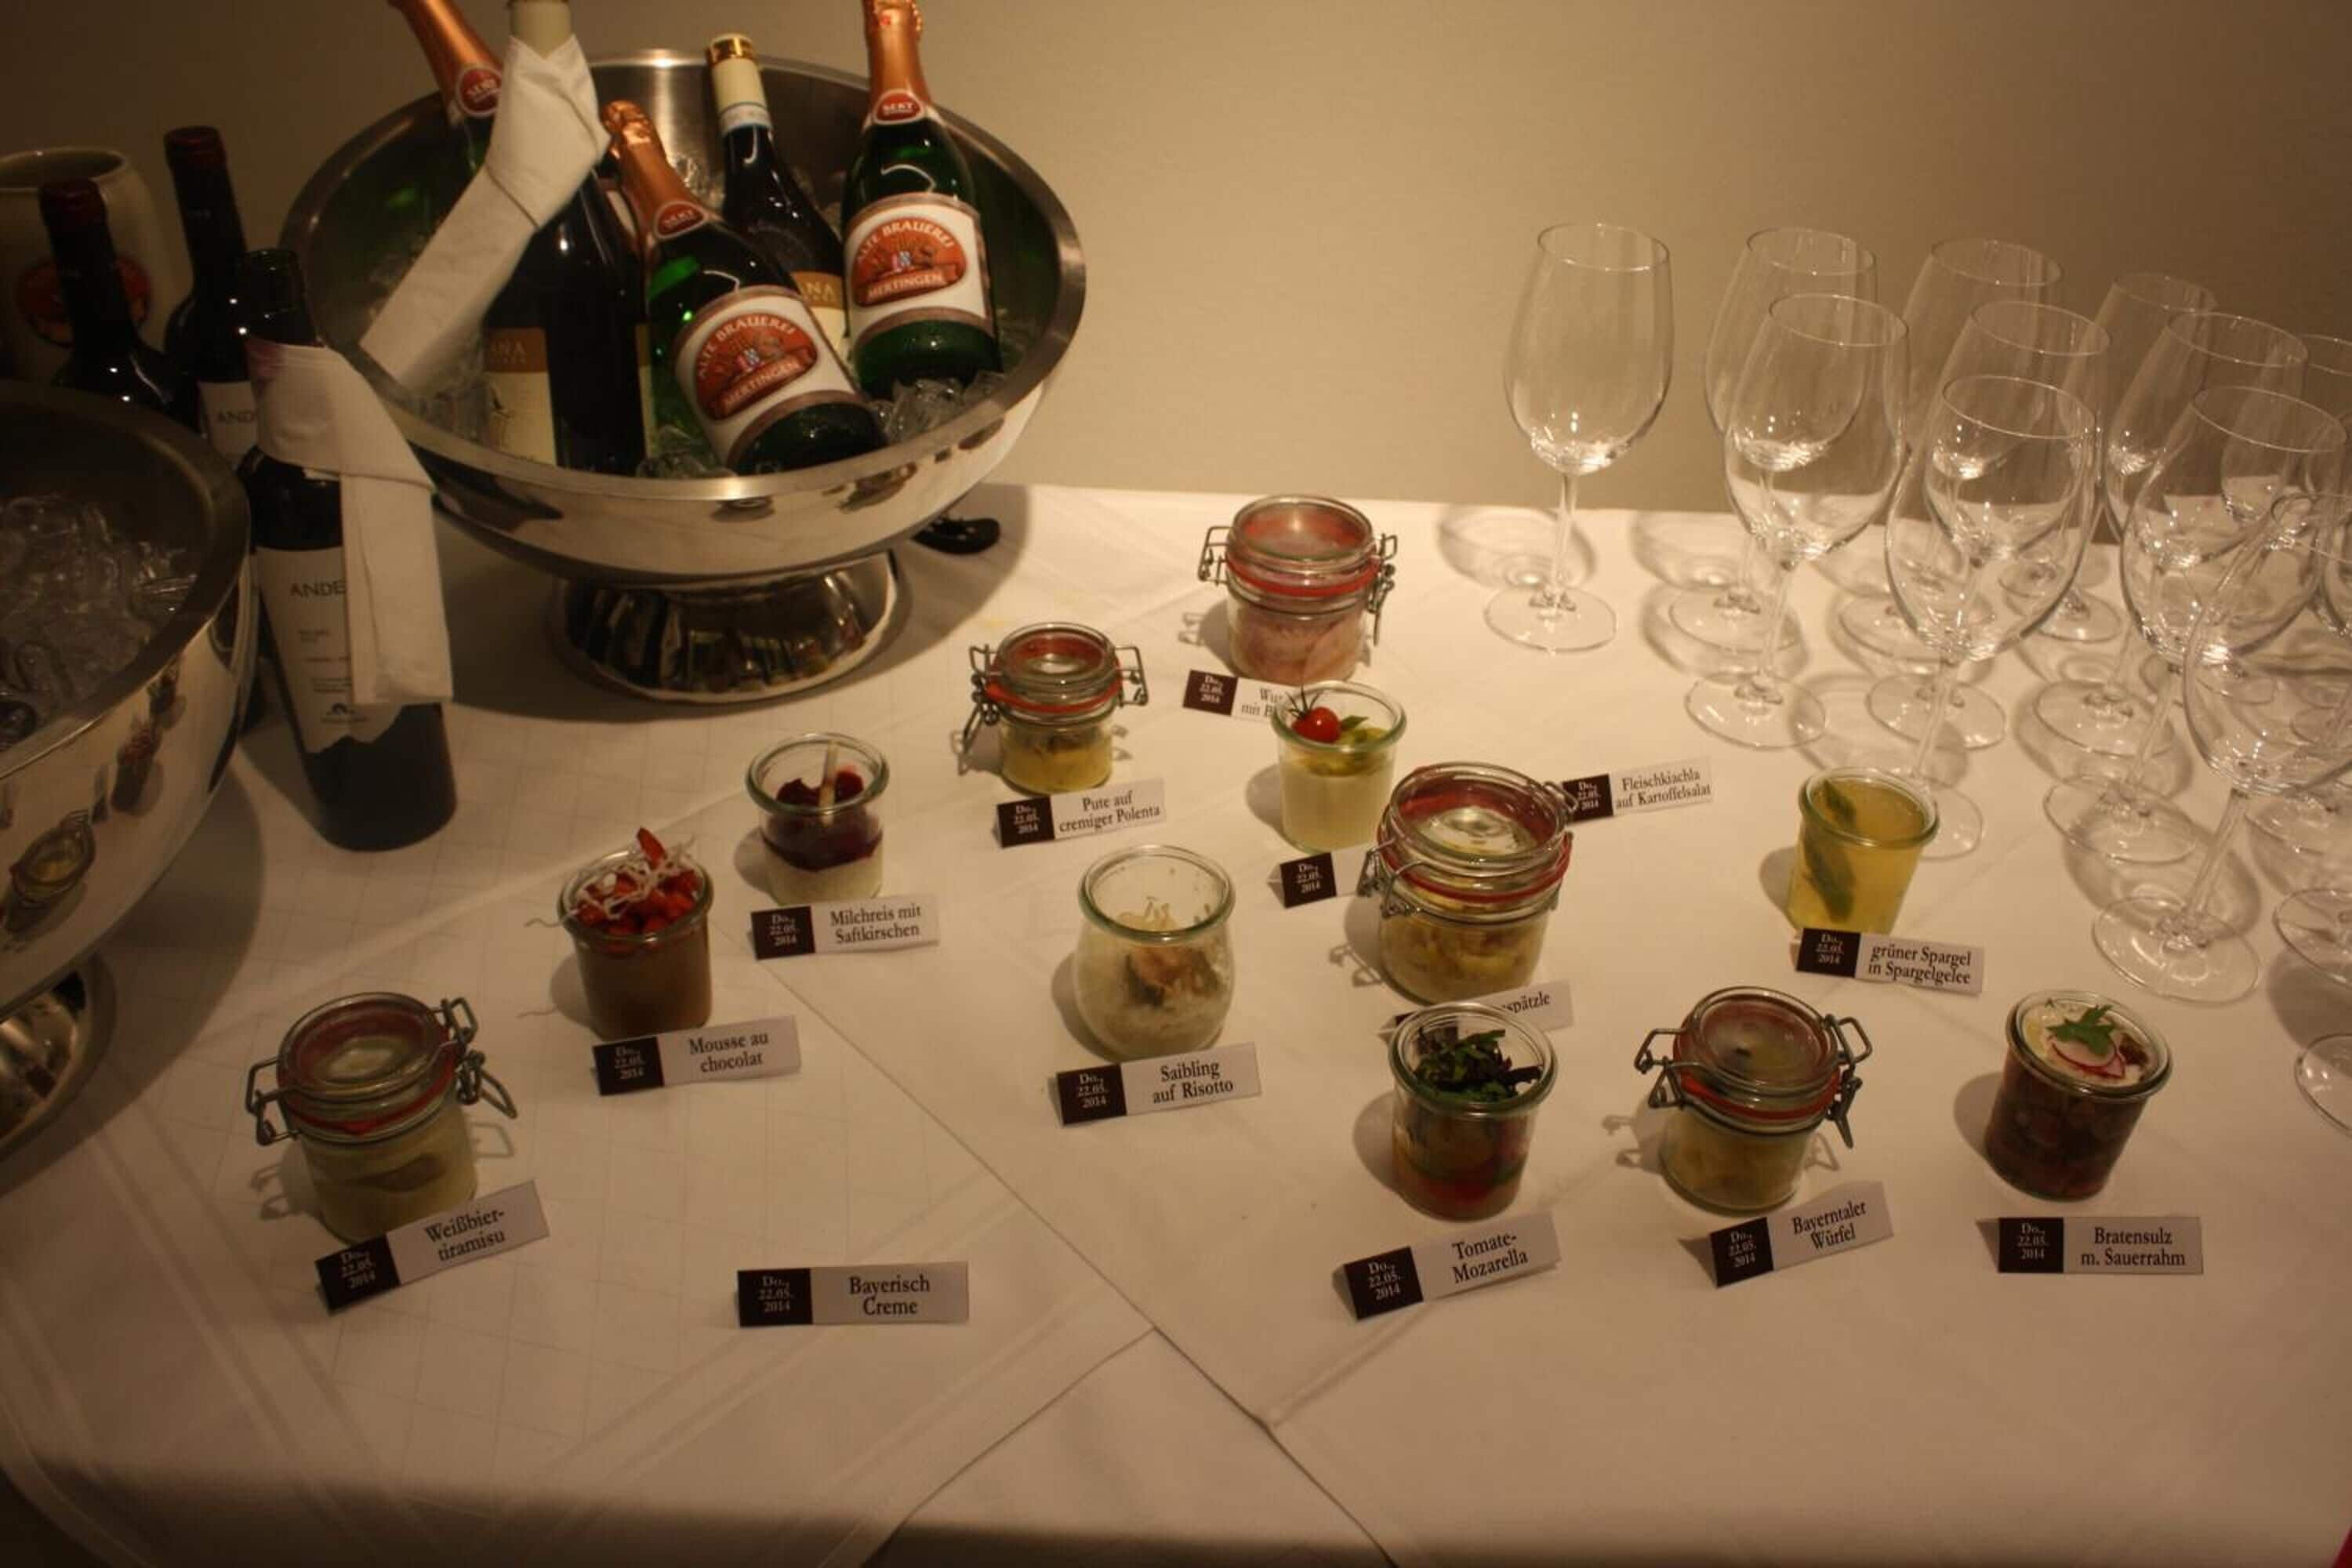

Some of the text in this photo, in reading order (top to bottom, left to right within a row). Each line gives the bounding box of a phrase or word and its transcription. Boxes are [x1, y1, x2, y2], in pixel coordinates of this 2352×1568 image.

[883, 220, 955, 248] BRAUEREI
[714, 315, 797, 342] BRAUEREI
[1082, 789, 1134, 812] Pute auf
[1615, 783, 1712, 810] auf Kartoffelsalat
[1058, 804, 1161, 833] cremiger Polenta
[829, 903, 922, 927] Milchreis mit
[835, 923, 920, 946] Saftkirschen
[1870, 943, 1972, 968] grüner Spargel
[1867, 960, 1972, 987] in Spargelgelee
[688, 1032, 770, 1056] Mousse au
[700, 1051, 765, 1074] chocolat
[1160, 1060, 1221, 1083] Saibling
[1082, 1095, 1108, 1109] 2014
[1152, 1078, 1235, 1105] auf Risotto
[424, 1207, 506, 1243] Weißbier-
[1791, 1200, 1867, 1236] Bayerntaler
[437, 1229, 506, 1262] tiramisu
[1450, 1231, 1518, 1261] Tomate-
[1809, 1222, 1857, 1250] Würfel
[2094, 1225, 2173, 1245] Bratensulz
[1451, 1248, 1530, 1284] Mozarella
[1733, 1254, 1756, 1269] 2014
[2020, 1247, 2045, 1261] 2014
[2081, 1248, 2187, 1267] m. Sauerrahm
[848, 1272, 931, 1300] Bayerisch
[1375, 1283, 1401, 1301] 2014
[764, 1300, 792, 1314] 2014
[862, 1296, 919, 1316] Creme
